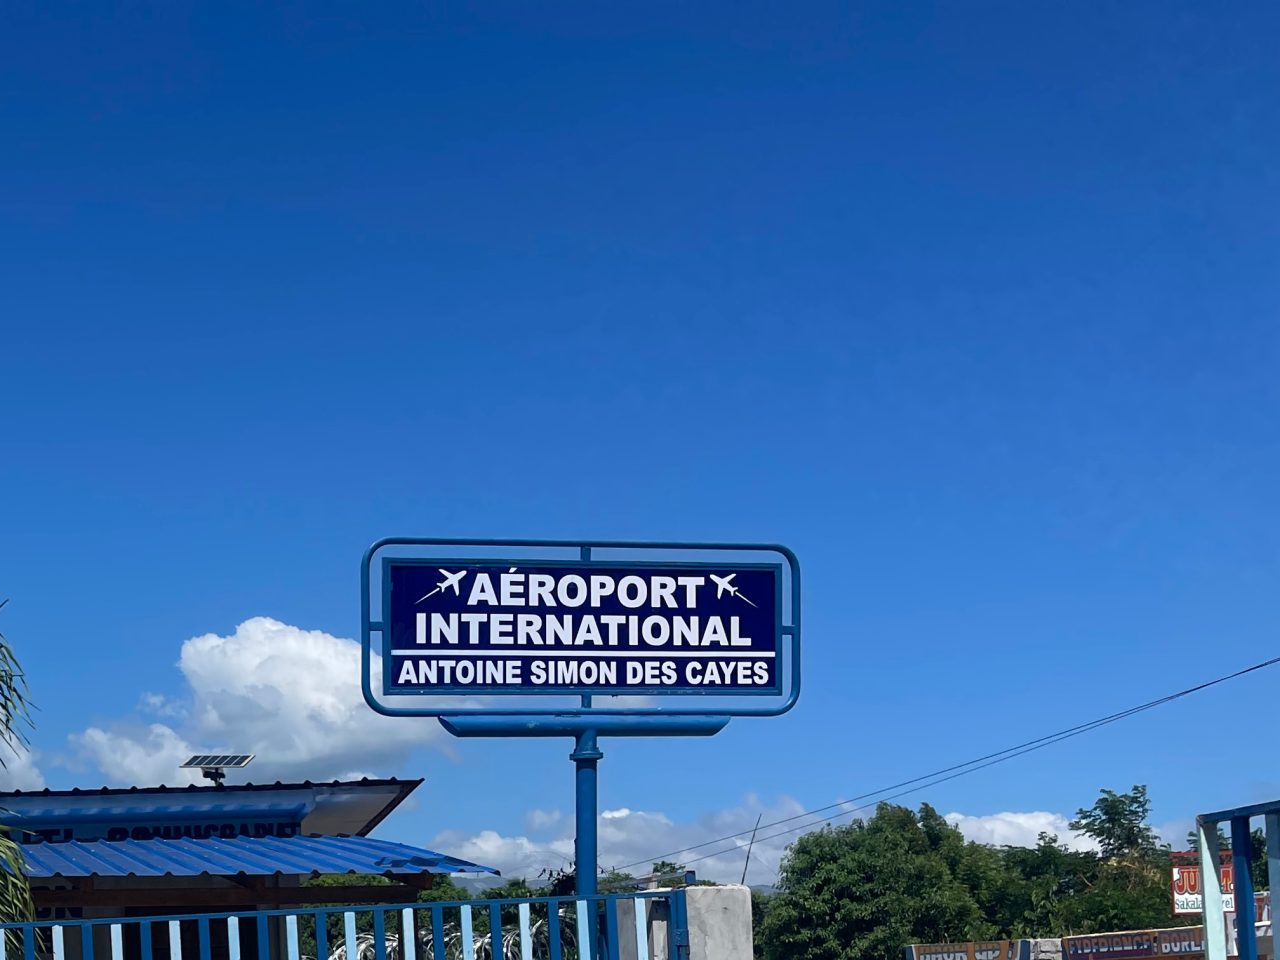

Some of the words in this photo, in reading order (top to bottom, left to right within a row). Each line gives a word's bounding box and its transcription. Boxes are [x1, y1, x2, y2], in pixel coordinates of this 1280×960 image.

[467, 567, 705, 609] AÉROPORT
[415, 612, 752, 647] INTERNATIONAL
[397, 660, 522, 685] ANTOINE
[529, 660, 617, 685] SIMON
[626, 661, 678, 685] DES
[685, 661, 769, 685] CAYES
